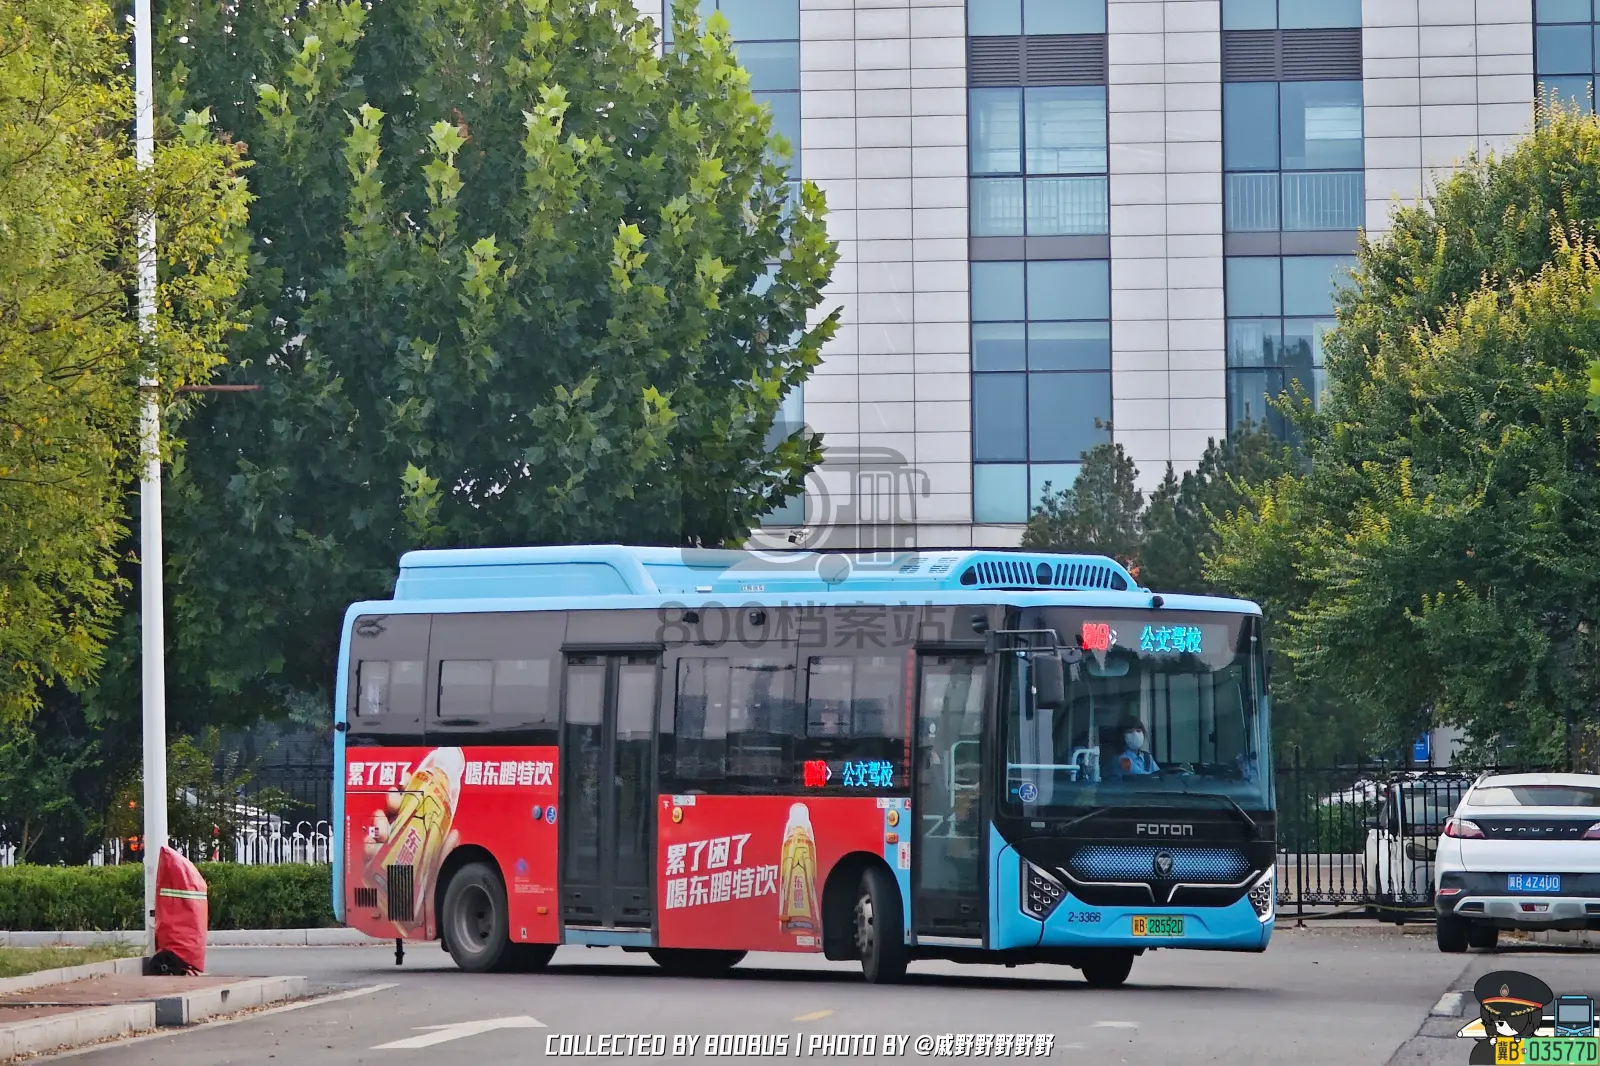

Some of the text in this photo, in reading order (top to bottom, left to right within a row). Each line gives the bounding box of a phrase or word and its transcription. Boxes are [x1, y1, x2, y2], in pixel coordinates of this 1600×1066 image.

[1140, 625, 1201, 653] 公交驾校
[347, 761, 412, 786] 累了困了
[464, 761, 554, 786] 喝东鹏特饮
[842, 761, 893, 787] 公交驾校
[1136, 823, 1193, 836] FOTON
[665, 833, 752, 876] 累了困了
[665, 864, 779, 910] 喝东鹏特饮
[1067, 911, 1102, 923] 2-3366
